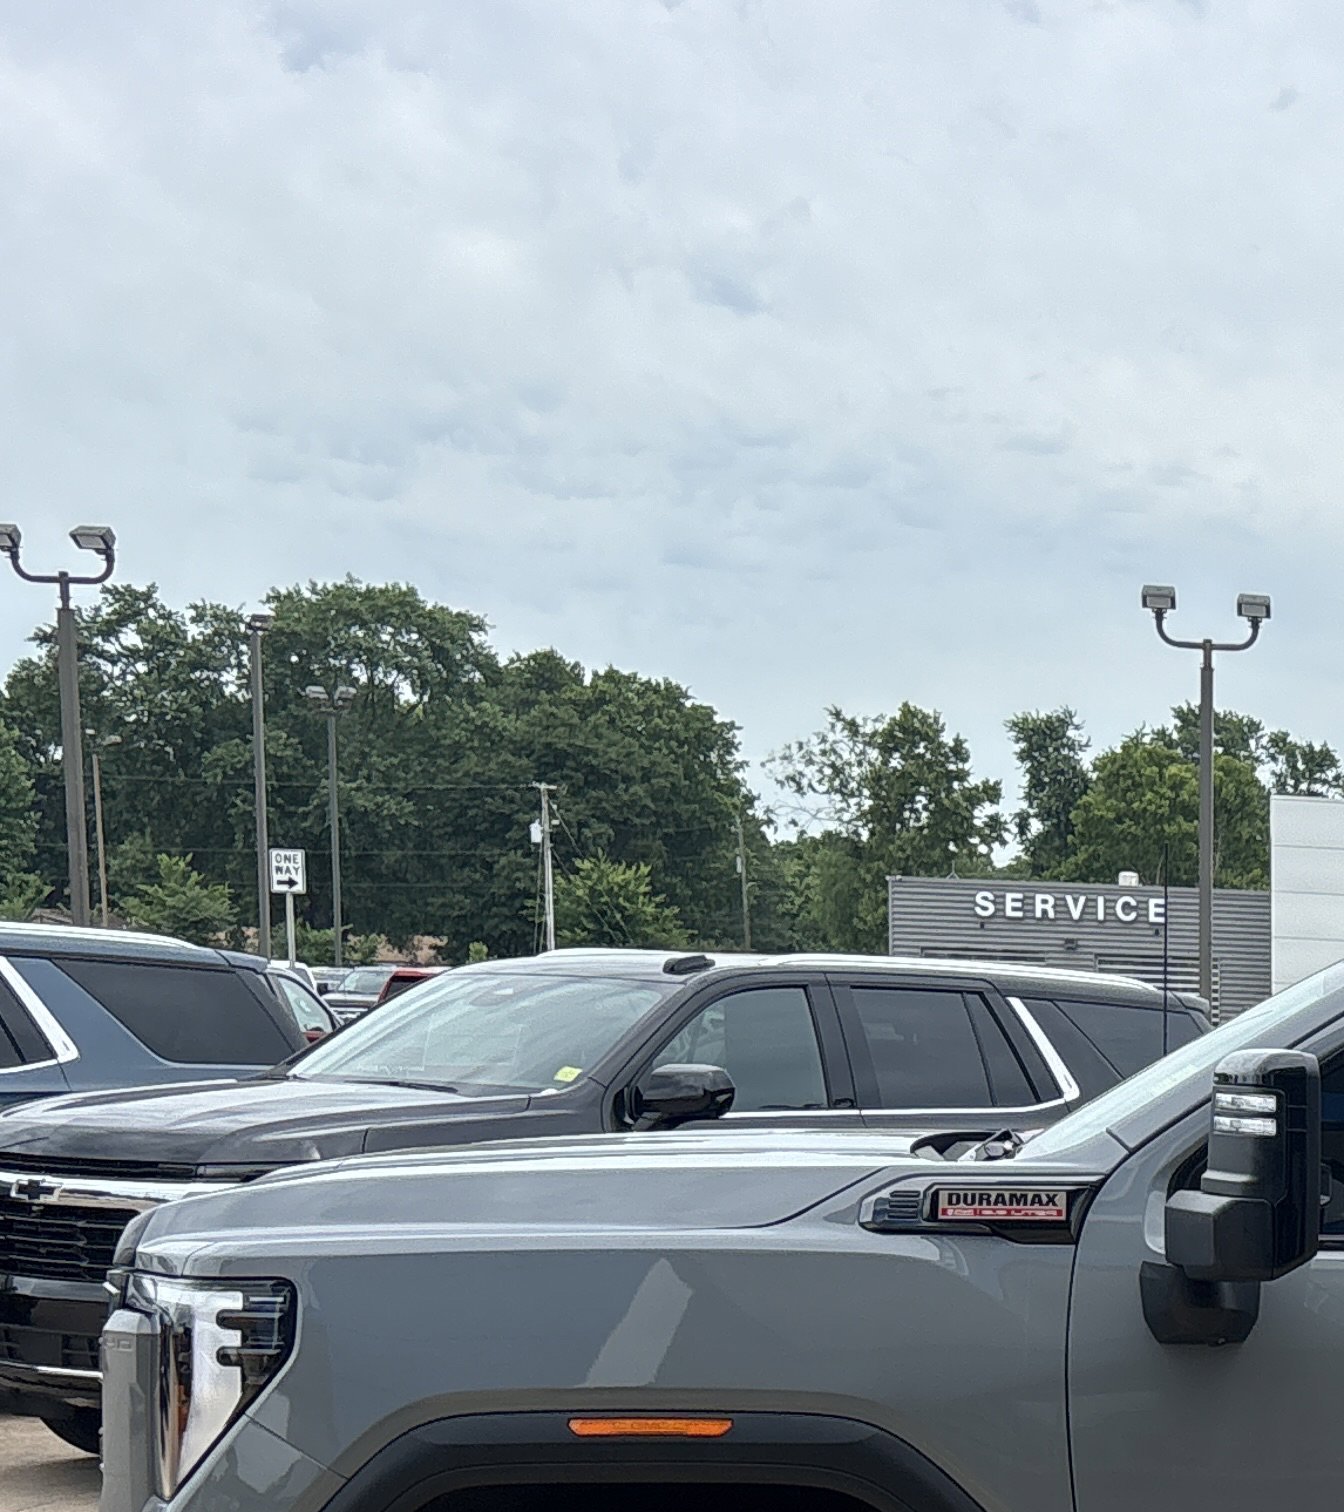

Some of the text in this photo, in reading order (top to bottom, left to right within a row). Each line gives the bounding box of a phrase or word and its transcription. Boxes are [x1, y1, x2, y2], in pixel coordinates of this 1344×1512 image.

[275, 853, 299, 864] ONE
[275, 865, 300, 876] WAY
[974, 891, 1165, 923] SERVICE
[947, 1192, 1059, 1206] DURAMAX
